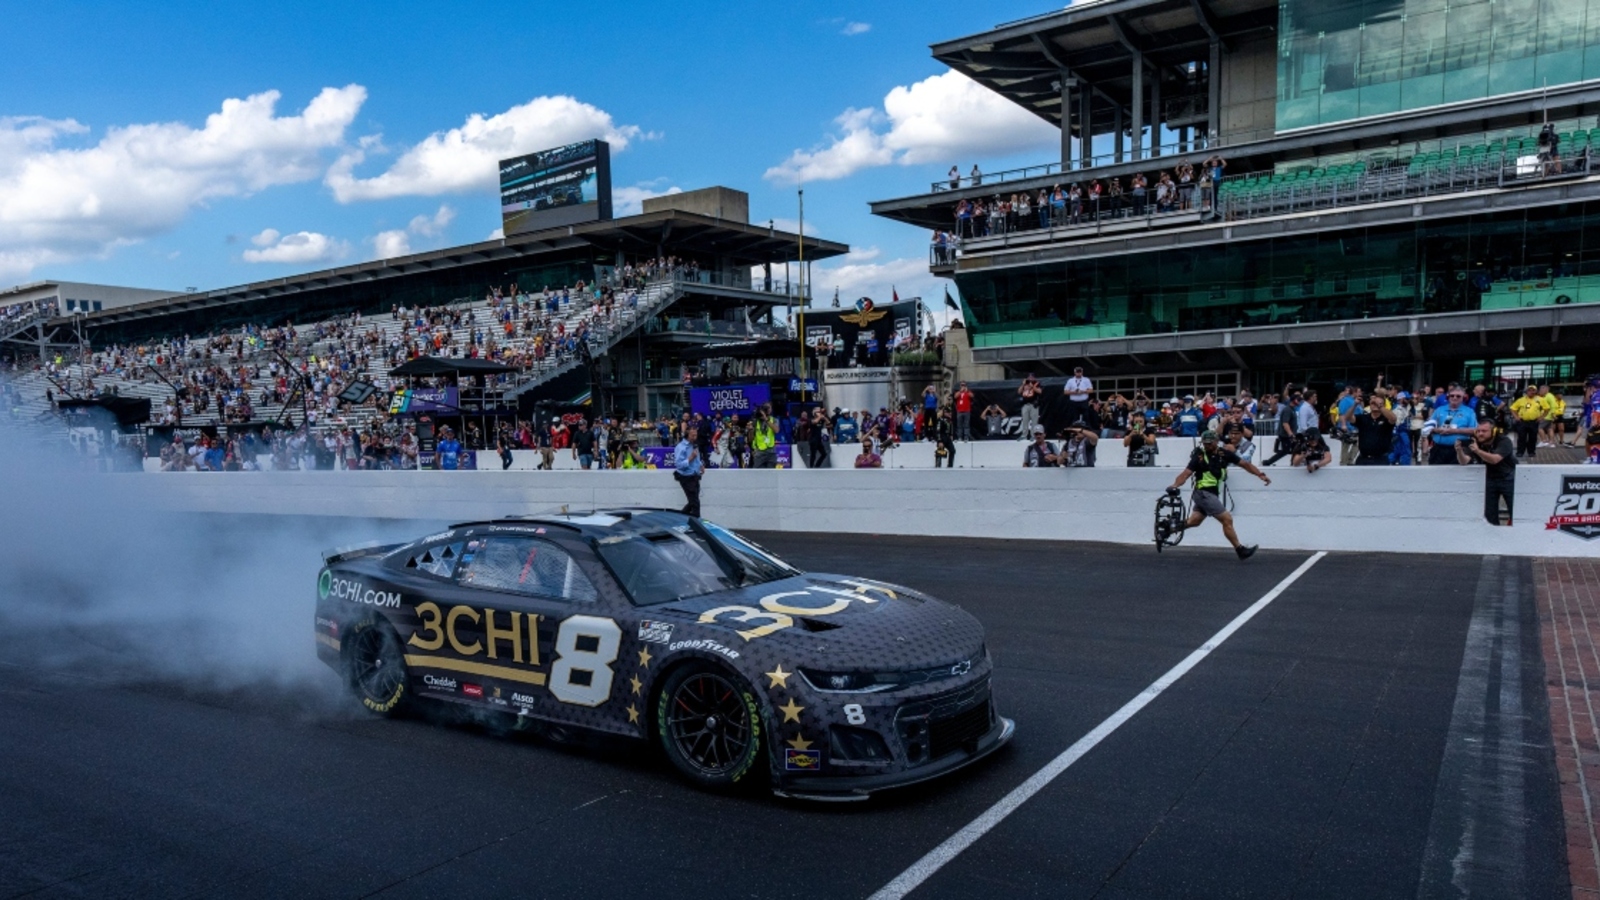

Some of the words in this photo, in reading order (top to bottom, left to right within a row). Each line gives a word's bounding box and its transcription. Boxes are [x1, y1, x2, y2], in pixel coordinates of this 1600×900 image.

[340, 380, 376, 404] 51
[711, 390, 743, 401] VIOLET
[709, 399, 749, 411] DEFENSE
[330, 578, 402, 608] 3CHI.COM
[407, 601, 541, 666] 3CHI
[549, 614, 622, 707] 8
[669, 639, 740, 659] GOODYEAR
[463, 685, 482, 696] Lenovo
[843, 703, 867, 726] 8
